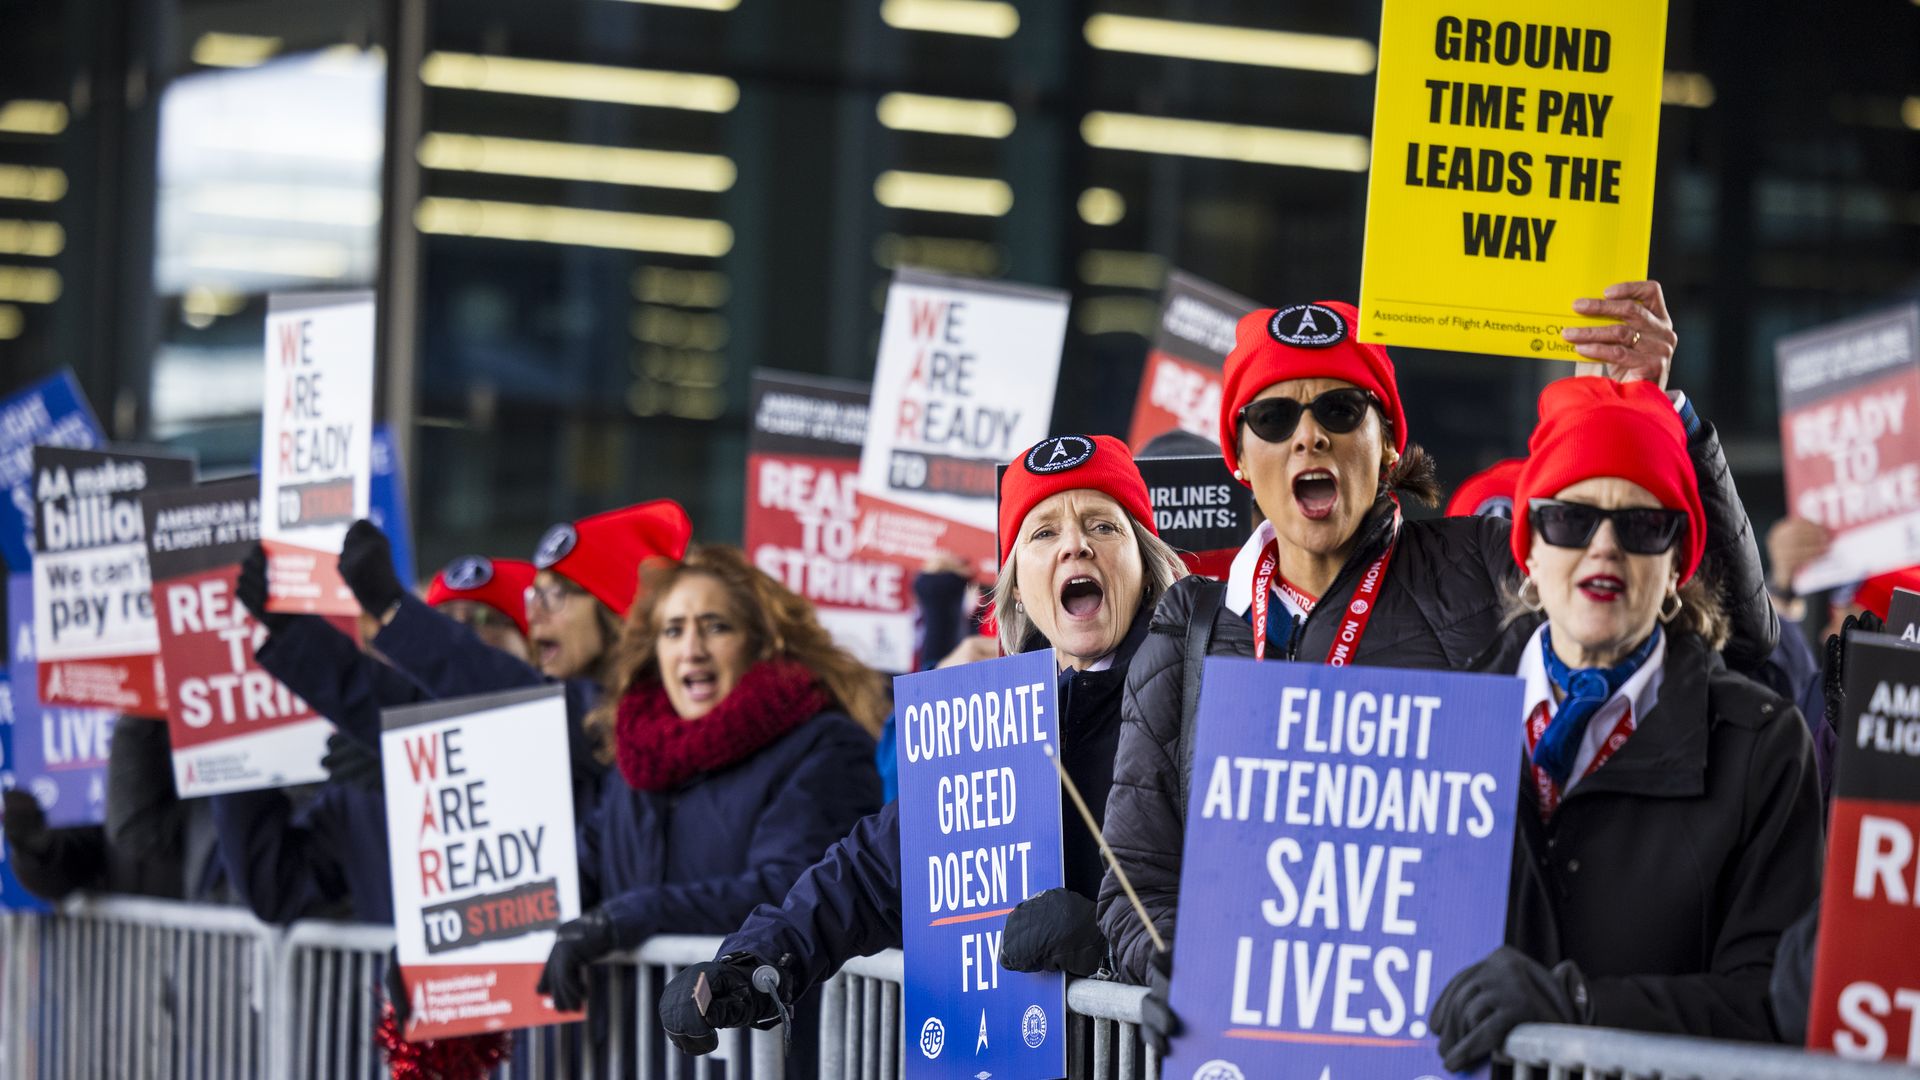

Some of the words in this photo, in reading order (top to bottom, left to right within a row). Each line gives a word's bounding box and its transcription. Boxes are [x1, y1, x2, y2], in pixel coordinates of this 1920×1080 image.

[1434, 15, 1611, 73] GROUND
[1425, 79, 1526, 131] TIME
[1536, 90, 1614, 138] PAY
[1405, 142, 1533, 197] LEADS
[1544, 154, 1622, 204] THE
[1462, 211, 1557, 263] WAY
[279, 319, 313, 366] WE
[910, 294, 967, 345] WE
[1373, 309, 1434, 325] Association
[1438, 316, 1450, 326] of
[1452, 317, 1481, 333] Flight
[1546, 340, 1576, 353] Unite
[282, 373, 323, 423] ARE
[907, 350, 977, 398] ARE
[898, 401, 1021, 451] READY
[1791, 385, 1907, 459] READY
[278, 425, 353, 476] READY
[891, 450, 928, 489] TO
[37, 463, 71, 500] AA
[73, 456, 147, 493] makes
[1150, 485, 1231, 507] IRLINES
[153, 526, 212, 553] FLIGHT
[157, 500, 246, 531] AMERICAN
[796, 512, 855, 562] TO
[46, 564, 86, 588] We
[755, 545, 901, 609] STRIKE
[1256, 577, 1268, 615] MORE
[1360, 560, 1383, 593] NOW!
[51, 592, 103, 644] pay
[1257, 615, 1266, 638] NO
[1341, 620, 1359, 642] NO
[1331, 643, 1349, 667] MO
[42, 711, 112, 765] LIVE
[904, 682, 1047, 764] CORPORATE
[1276, 686, 1442, 760] FLIGHT
[404, 727, 467, 785] WE
[419, 780, 490, 840] ARE
[937, 766, 1017, 835] GREED
[1201, 756, 1498, 838] ATTENDANTS
[419, 826, 545, 899] READY
[928, 841, 1032, 914] DOESN'T
[1261, 837, 1422, 936] SAVE
[425, 909, 463, 948] TO
[466, 888, 561, 937] STRIKE
[961, 929, 1002, 993] FLY
[1230, 936, 1433, 1039] LIVES!
